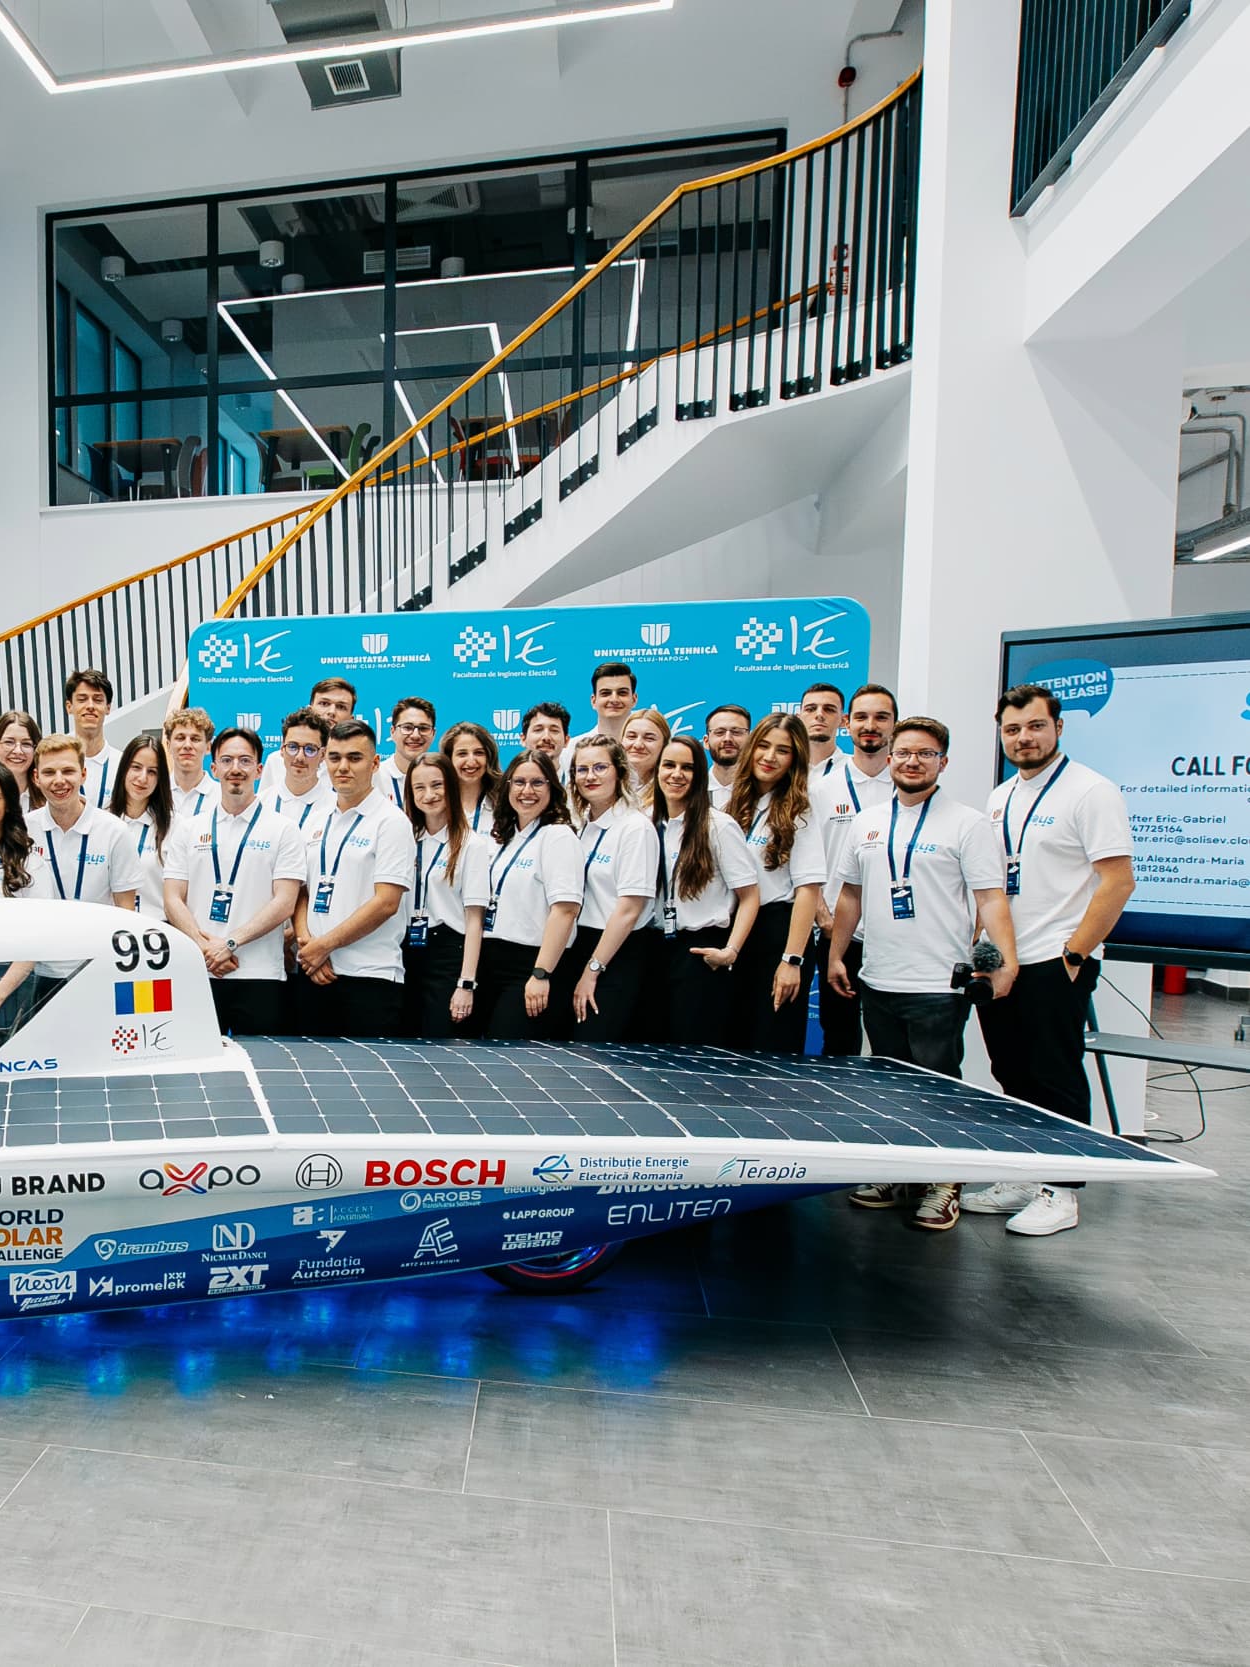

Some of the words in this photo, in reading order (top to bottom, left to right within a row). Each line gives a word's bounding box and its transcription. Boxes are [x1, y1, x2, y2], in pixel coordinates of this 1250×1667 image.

[594, 648, 670, 657] UNIVERSITATEA
[320, 656, 388, 664] UNIVERSITATEA
[783, 663, 816, 672] Inginerie
[1171, 755, 1226, 777] CALL
[1120, 785, 1137, 793] For
[1140, 784, 1188, 793] detailed
[1156, 815, 1226, 824] Eric-Gabriel
[1130, 825, 1183, 833] 47725164
[1131, 834, 1250, 845] ter.eric@solisev.clo
[1147, 855, 1244, 865] Alexandra-Maria
[111, 929, 170, 972] 99
[645, 1157, 689, 1169] Energie
[365, 1159, 506, 1187] BOSCH
[736, 1159, 807, 1181] Terapia
[11, 1172, 105, 1196] BRAND
[139, 1162, 261, 1196] axpo
[422, 1190, 482, 1203] AROBS
[607, 1199, 732, 1226] ENLITEN
[504, 1230, 563, 1242] TEHNO
[117, 1241, 190, 1255] trambus
[502, 1239, 561, 1251] LOGISTIC
[291, 1268, 365, 1280] Autonom
